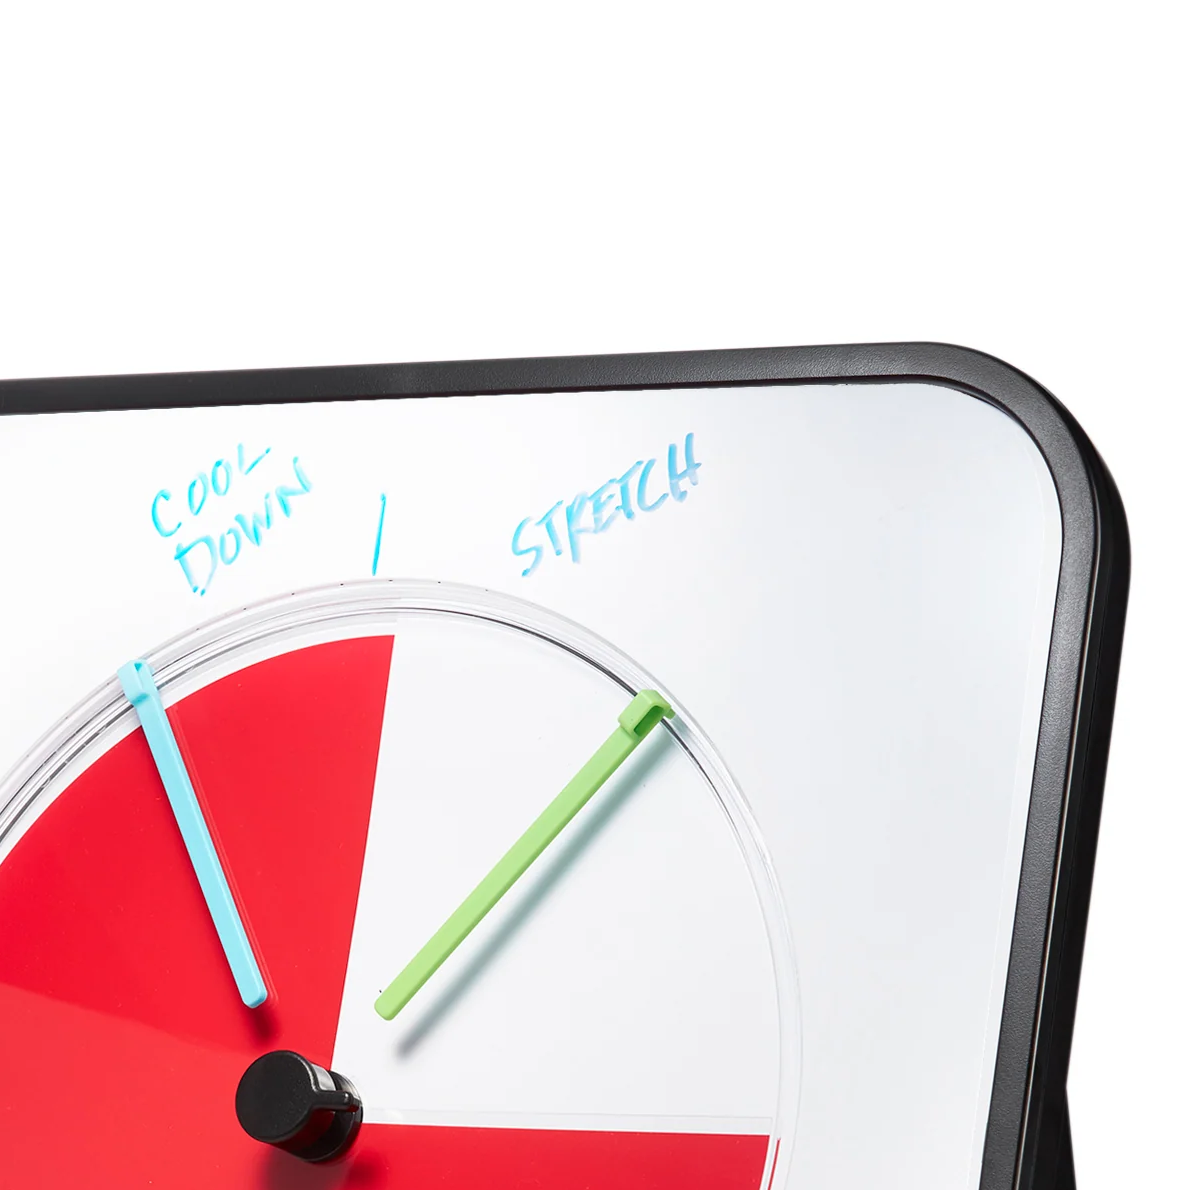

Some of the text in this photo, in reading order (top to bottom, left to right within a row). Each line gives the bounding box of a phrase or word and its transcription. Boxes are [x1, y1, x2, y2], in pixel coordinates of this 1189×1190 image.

[150, 442, 272, 539] COOL
[172, 455, 313, 598] DOWN
[510, 431, 703, 578] STRETCH
